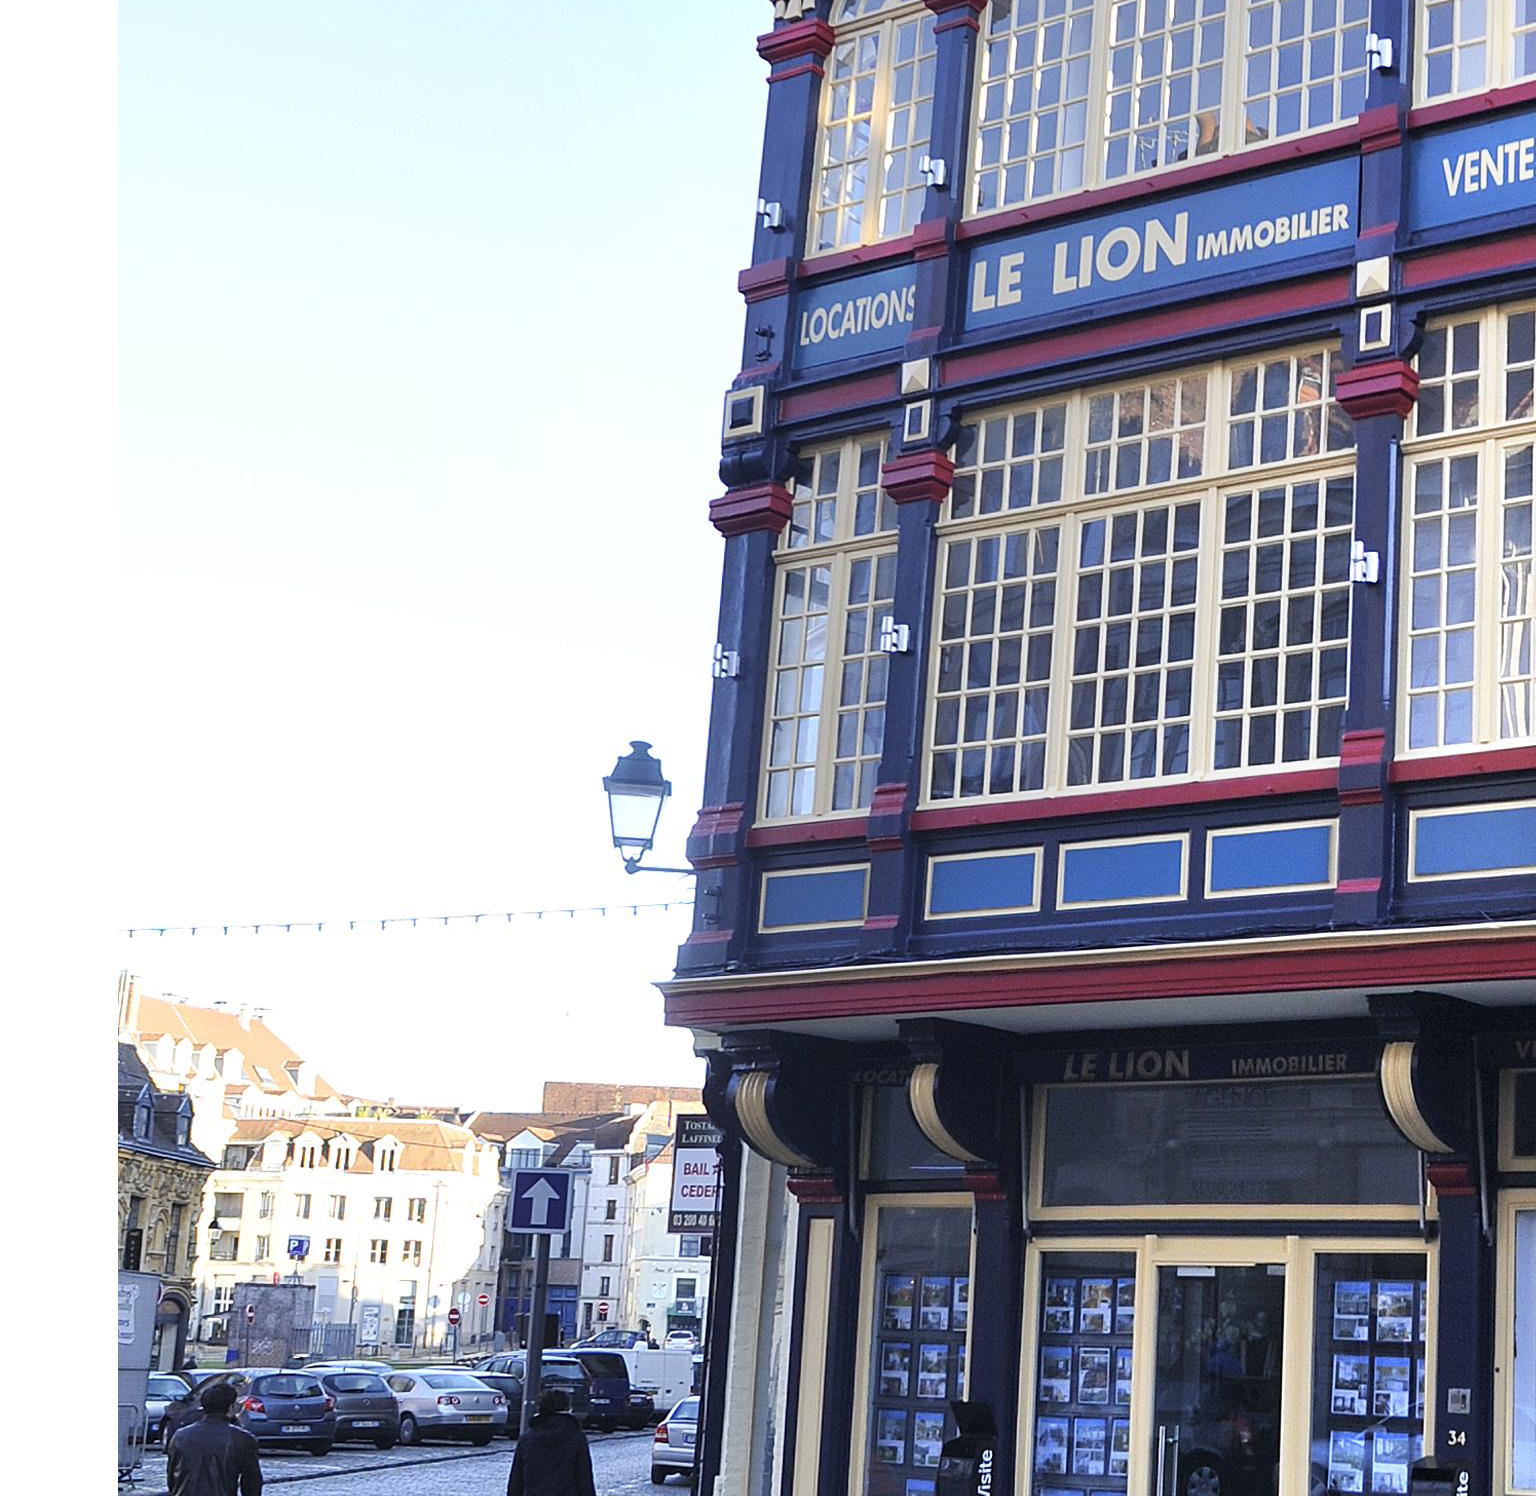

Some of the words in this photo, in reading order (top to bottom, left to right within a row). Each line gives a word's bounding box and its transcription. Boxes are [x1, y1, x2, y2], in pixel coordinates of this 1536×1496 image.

[971, 251, 1025, 313] LE
[1052, 211, 1189, 295] LION
[1196, 203, 1350, 262] IMMOBILIER
[800, 284, 917, 346] LOCATIONS
[1063, 1054, 1098, 1080] LE
[1107, 1050, 1190, 1080] LION
[1231, 1054, 1348, 1076] IMMOBILIER
[683, 1163, 710, 1176] BAIL
[1447, 1429, 1467, 1446] 34
